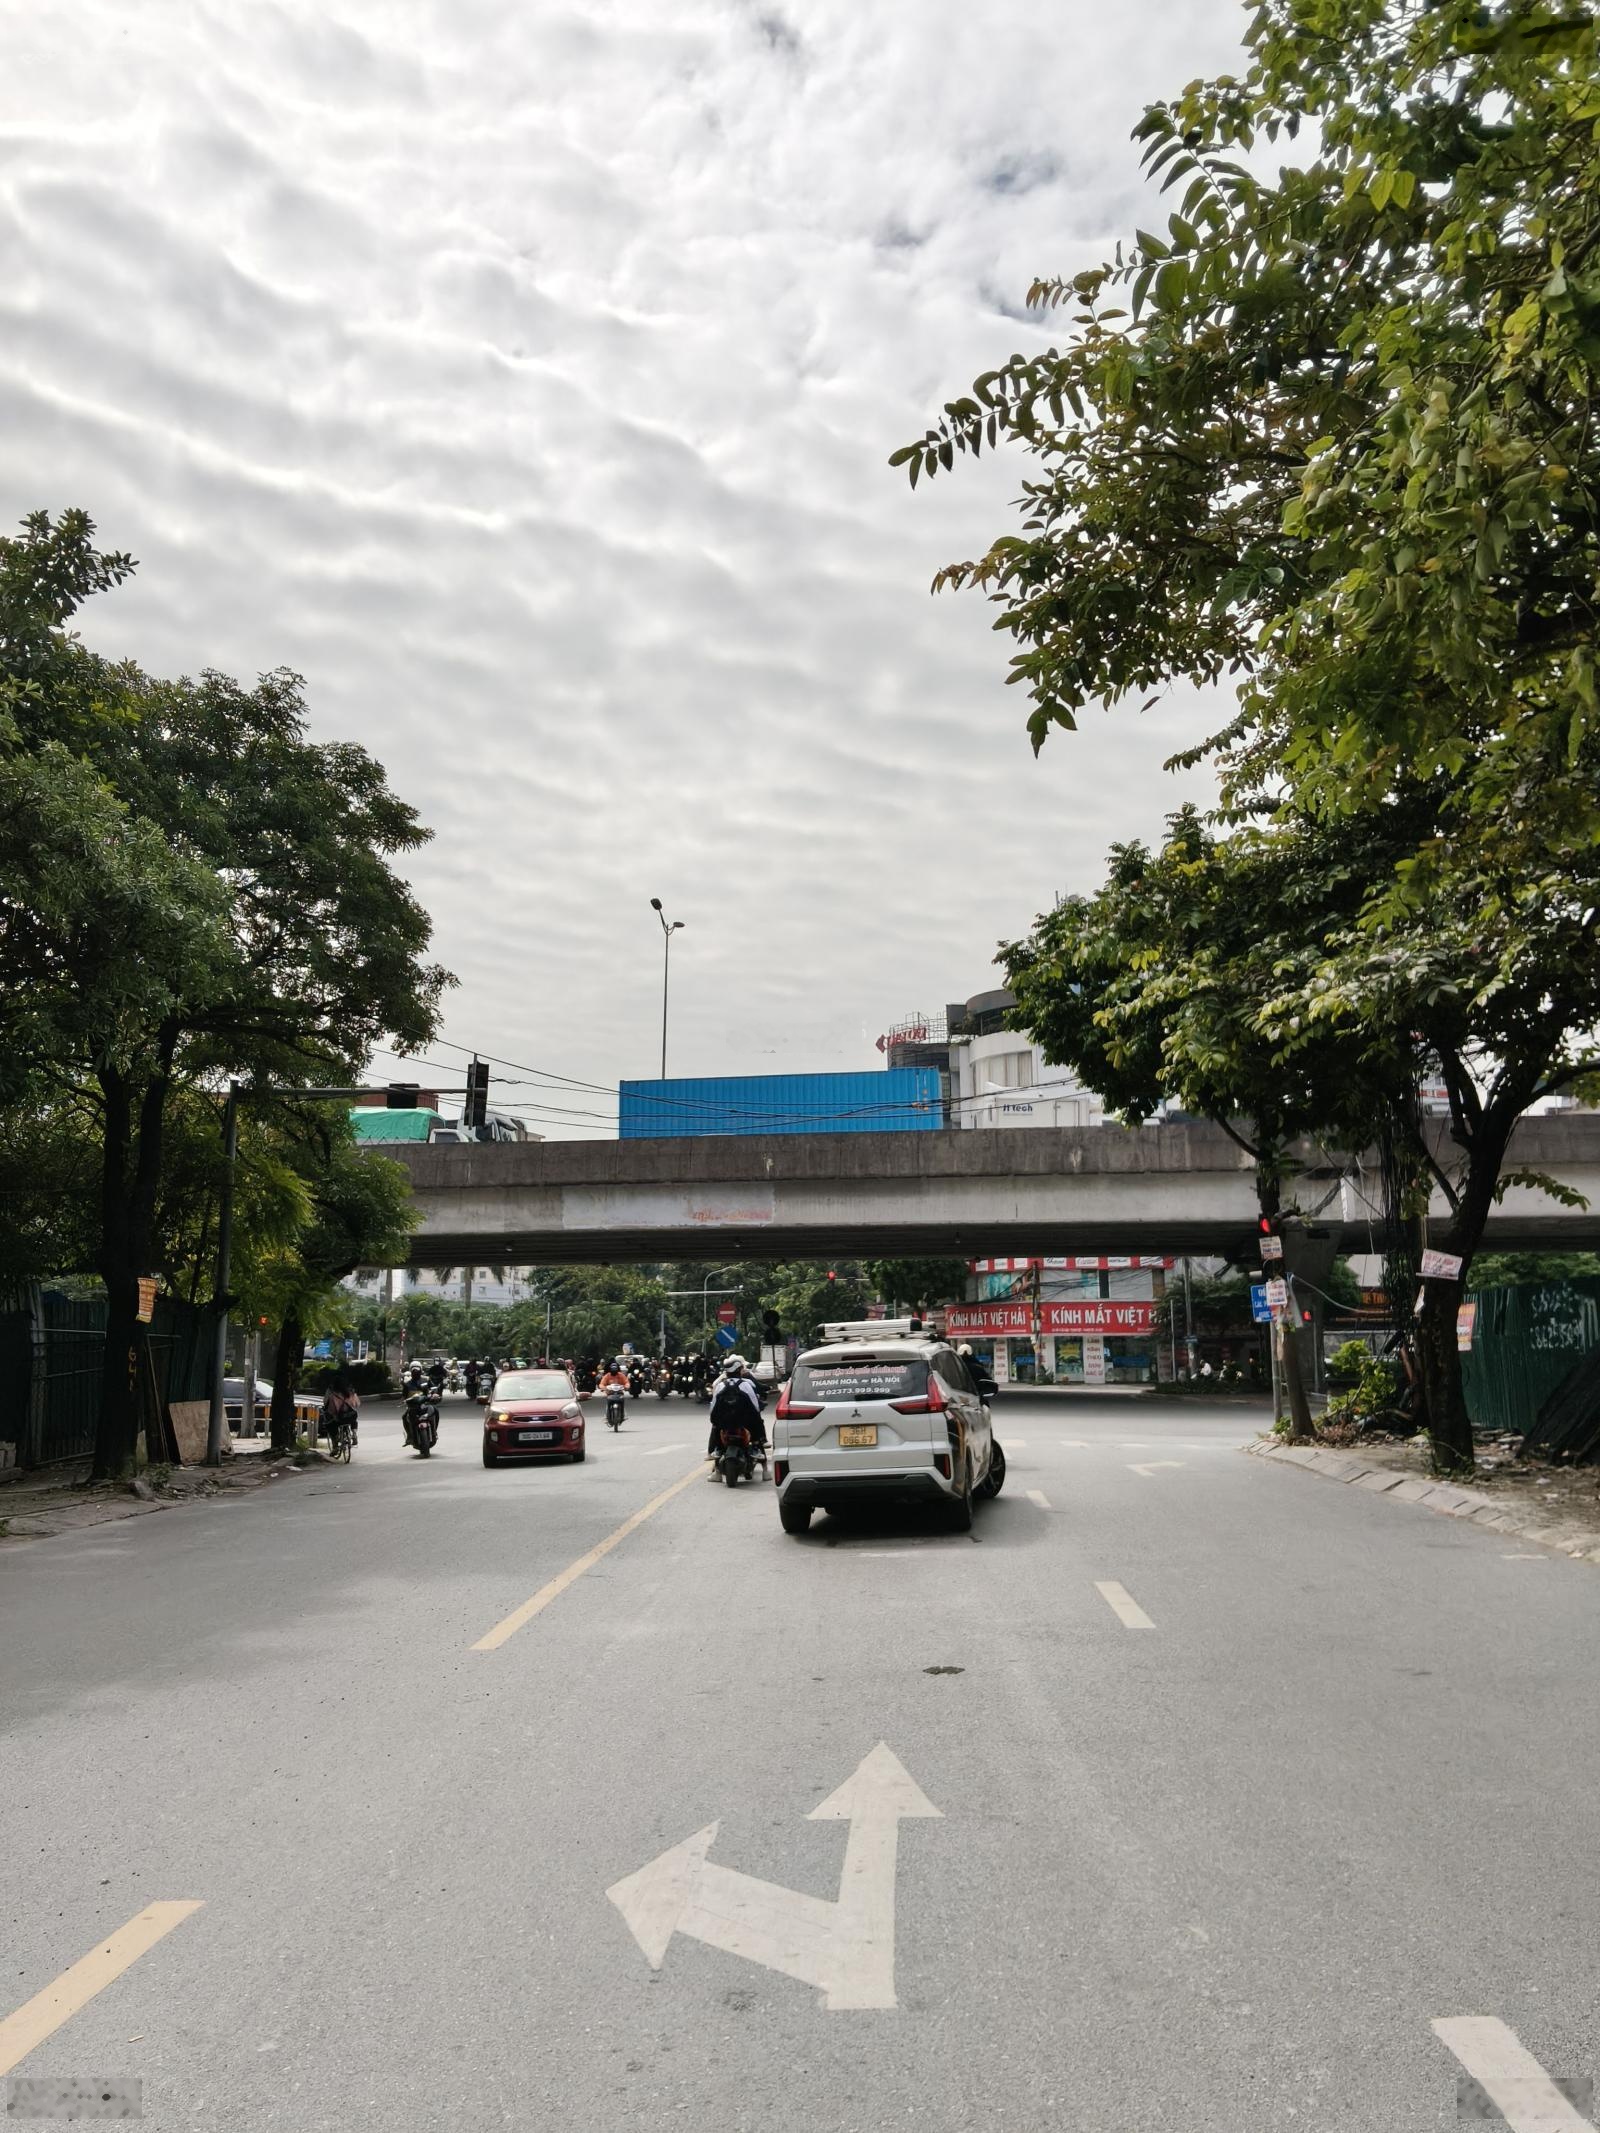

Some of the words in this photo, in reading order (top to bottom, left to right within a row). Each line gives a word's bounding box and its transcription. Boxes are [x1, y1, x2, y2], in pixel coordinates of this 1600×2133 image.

[949, 1310, 969, 1327] KÍNH
[990, 1308, 1009, 1328] VIỆT
[1010, 1306, 1026, 1326] HẢI
[1051, 1306, 1082, 1325] KÍNH
[1084, 1302, 1112, 1325] MẮT
[1116, 1306, 1144, 1327] VIỆT
[811, 1379, 839, 1387] THANH
[870, 1376, 883, 1384] HÀ
[884, 1376, 900, 1385] NỘI
